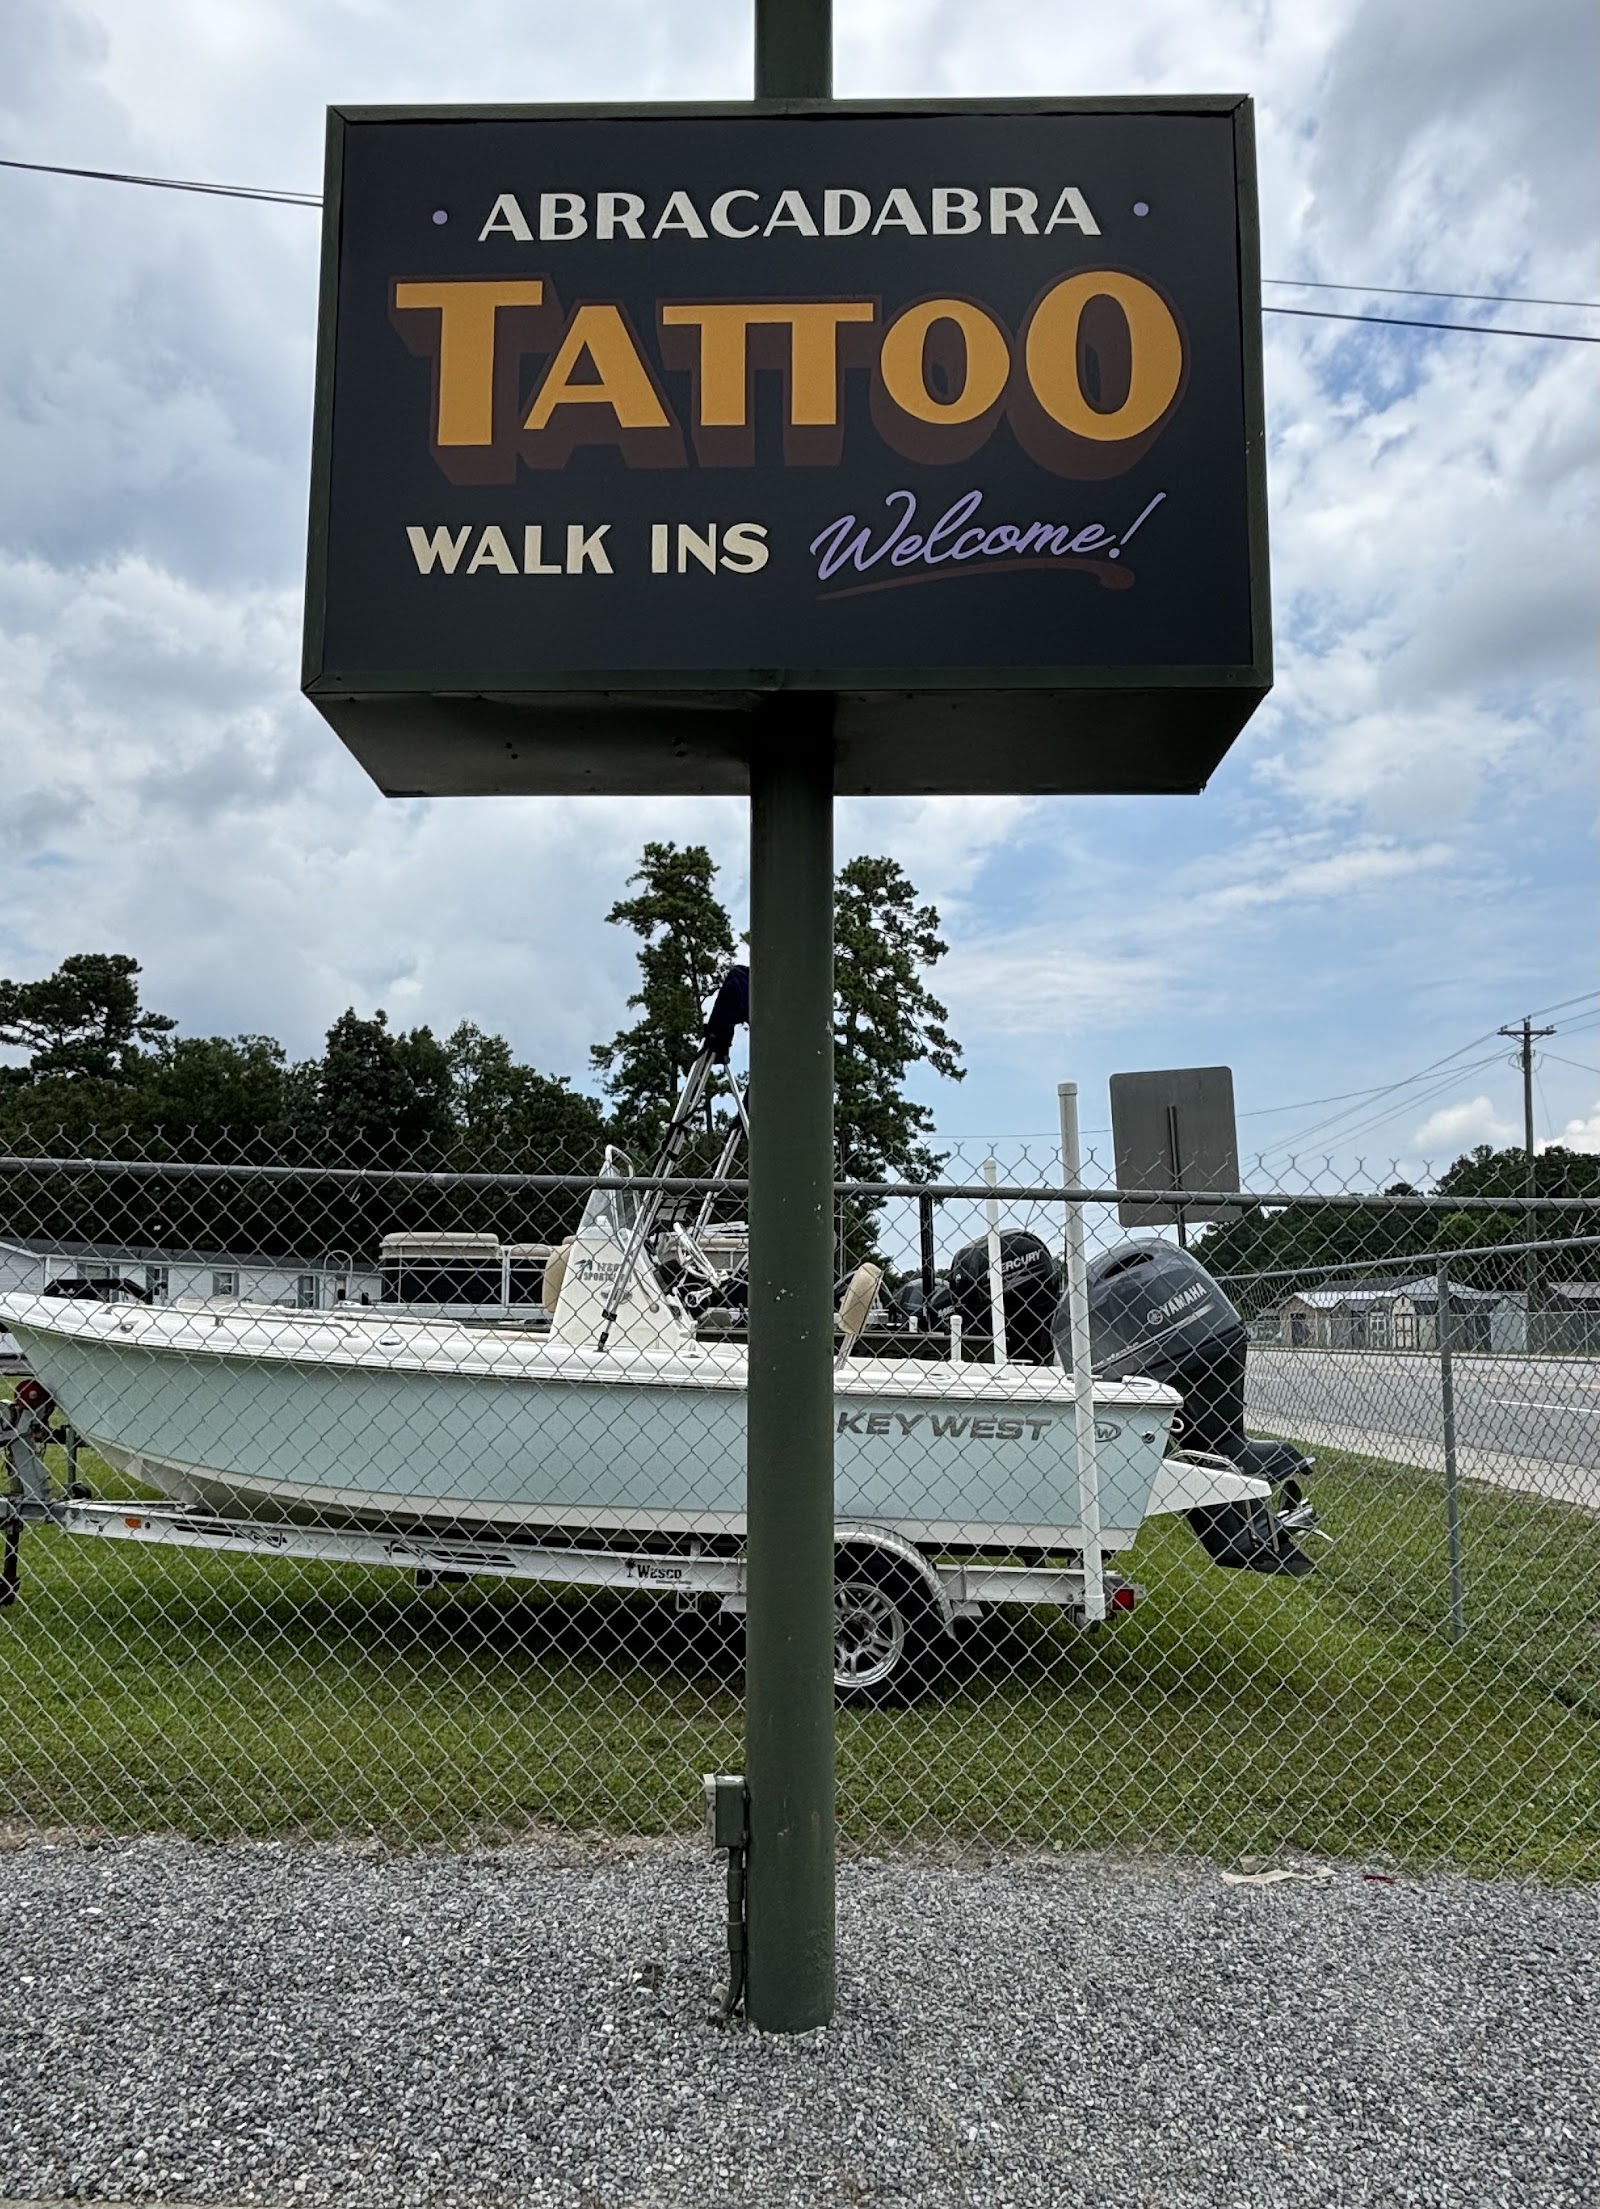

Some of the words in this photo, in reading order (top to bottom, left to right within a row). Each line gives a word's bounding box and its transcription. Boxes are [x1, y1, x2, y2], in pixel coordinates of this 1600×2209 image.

[478, 187, 1102, 242] ABRACADABRA
[395, 270, 1183, 447] TATTOO
[406, 525, 614, 576] WALK
[651, 523, 769, 576] INS
[810, 489, 1167, 581] Welcome!
[987, 1249, 1043, 1279] ERCURY
[1158, 1282, 1208, 1317] YAMAHA
[837, 1412, 923, 1435] KEY
[931, 1414, 1052, 1440] WEST
